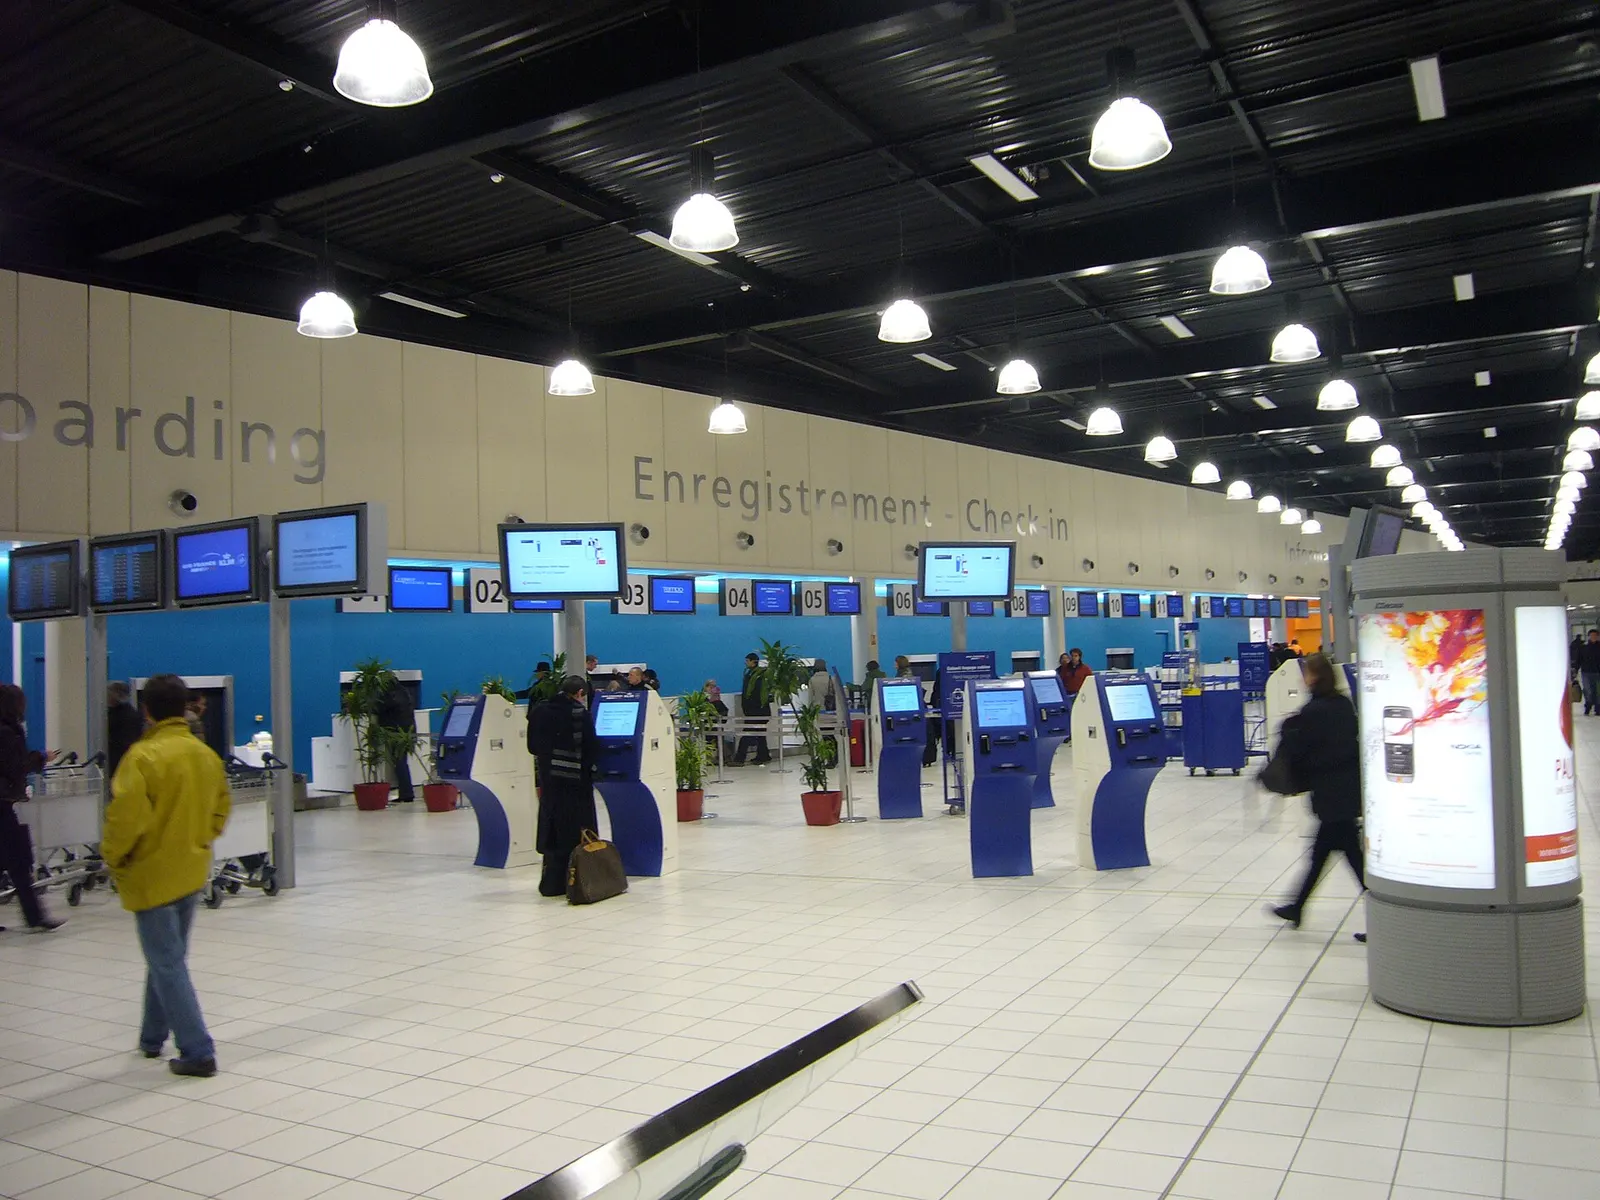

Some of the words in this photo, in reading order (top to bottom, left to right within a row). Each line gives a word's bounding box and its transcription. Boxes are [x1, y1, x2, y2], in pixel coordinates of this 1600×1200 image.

[634, 456, 931, 527] Enregistrement
[966, 499, 1069, 541] Check-in
[475, 579, 503, 604] 02
[729, 588, 749, 607] 04
[804, 590, 822, 608] 05
[896, 592, 911, 609] 06
[1012, 596, 1025, 611] 08
[1065, 597, 1076, 611] 09
[1111, 599, 1120, 613] 10
[1157, 600, 1166, 614] 11
[1202, 602, 1210, 614] 12
